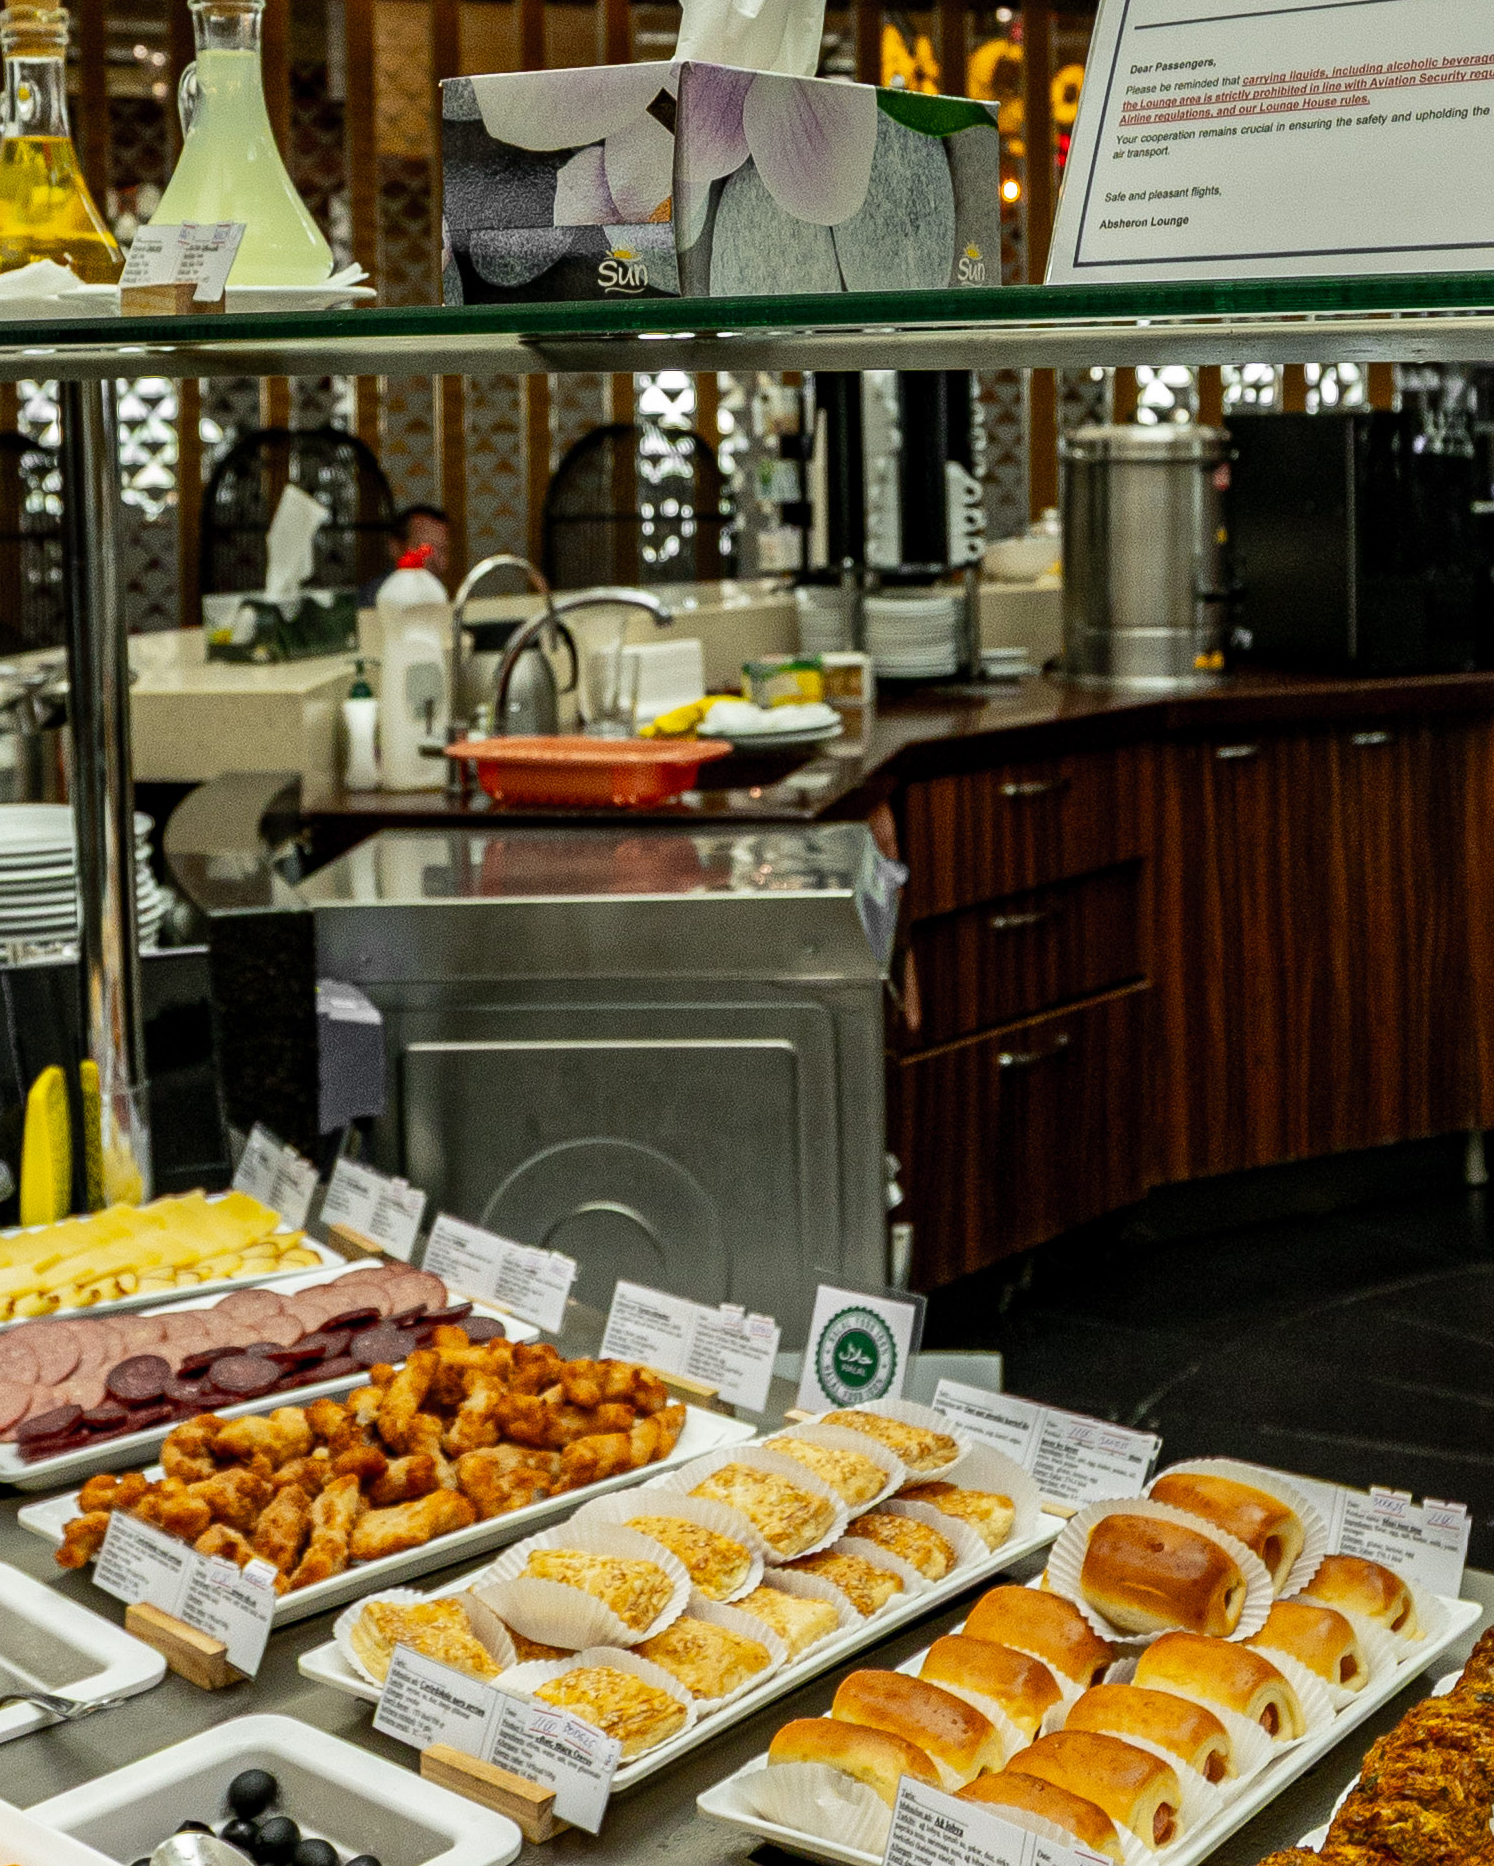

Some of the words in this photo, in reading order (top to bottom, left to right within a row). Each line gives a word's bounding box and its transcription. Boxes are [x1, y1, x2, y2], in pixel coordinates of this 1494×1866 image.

[1125, 84, 1157, 95] Please
[1159, 82, 1171, 92] be
[1173, 76, 1219, 90] reminded
[1221, 74, 1240, 86] that
[1241, 71, 1286, 87] carrying
[1287, 67, 1329, 83] liquids,
[1330, 62, 1383, 79] including
[1384, 57, 1438, 74] alcoholic
[1129, 64, 1153, 74] Dear
[1154, 58, 1216, 72] Passengers,
[1120, 100, 1138, 113] the
[1137, 97, 1177, 111] Lounge
[1177, 95, 1201, 107] area
[1201, 92, 1212, 105] is
[1212, 89, 1250, 104] strictly
[1251, 83, 1307, 100] prohibited
[1307, 83, 1319, 95] in
[1320, 81, 1342, 94] line
[1342, 78, 1367, 92] with
[1367, 74, 1416, 90] Aviation
[1416, 69, 1467, 86] Security
[1116, 134, 1138, 144] Your
[1140, 129, 1195, 143] cooperation
[1198, 125, 1237, 138] remains
[1240, 122, 1273, 134] crucial
[1275, 121, 1285, 131] in
[1288, 118, 1332, 130] ensuring
[1335, 116, 1352, 127] the
[1355, 113, 1388, 126] safety
[1390, 110, 1412, 122] and
[1414, 107, 1468, 122] upholding
[1472, 105, 1490, 116] the
[1118, 113, 1152, 127] Airline
[1152, 108, 1214, 124] regulations,
[1214, 104, 1237, 118] and
[1237, 104, 1257, 116] our
[1257, 101, 1299, 114] Lounge
[1300, 97, 1337, 111] House
[1111, 148, 1125, 159] air
[1126, 145, 1170, 158] transport.
[1104, 190, 1126, 202] Safe
[1127, 189, 1146, 201] and
[1147, 187, 1189, 202] pleasant
[1190, 185, 1221, 198] flights,
[1098, 218, 1148, 230] Absheron
[1149, 216, 1189, 227] Lounge
[598, 260, 649, 287] Sun
[958, 257, 985, 281] Sun
